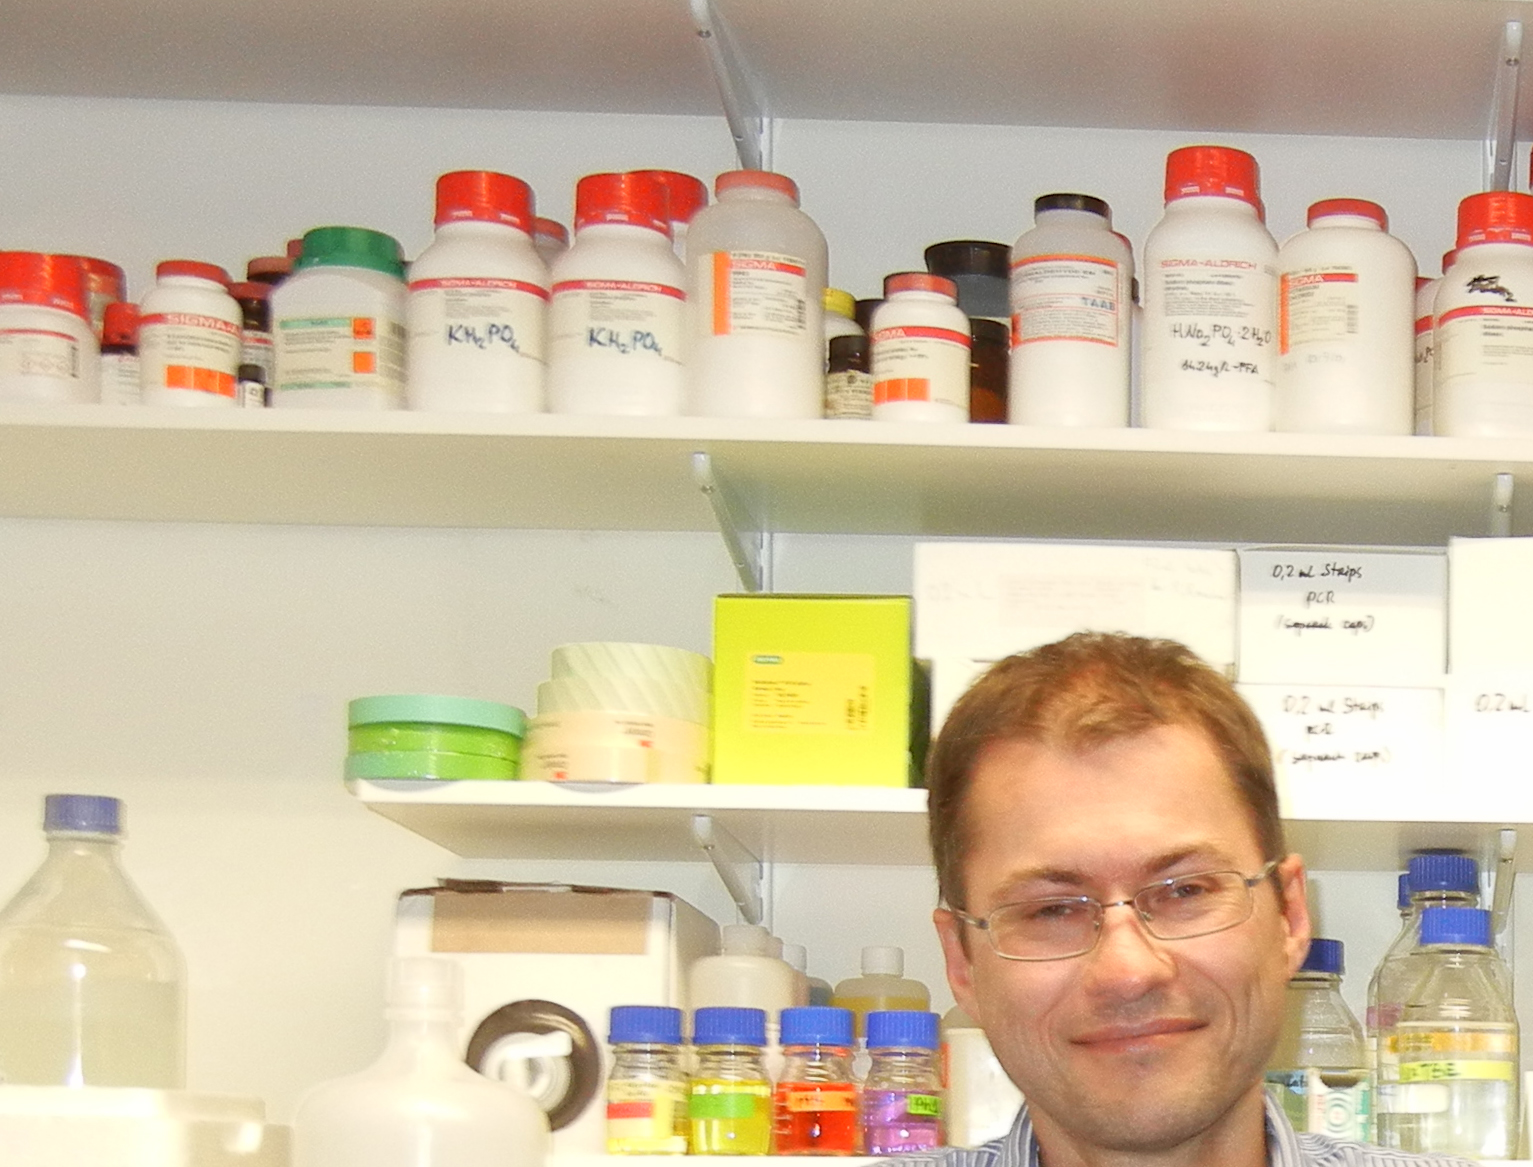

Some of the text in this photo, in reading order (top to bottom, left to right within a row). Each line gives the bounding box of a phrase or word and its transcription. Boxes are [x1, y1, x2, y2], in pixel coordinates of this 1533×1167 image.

[1161, 259, 1257, 270] SIGMA-ALDRICH
[1320, 562, 1363, 582] Strips
[1305, 590, 1336, 609] PCR
